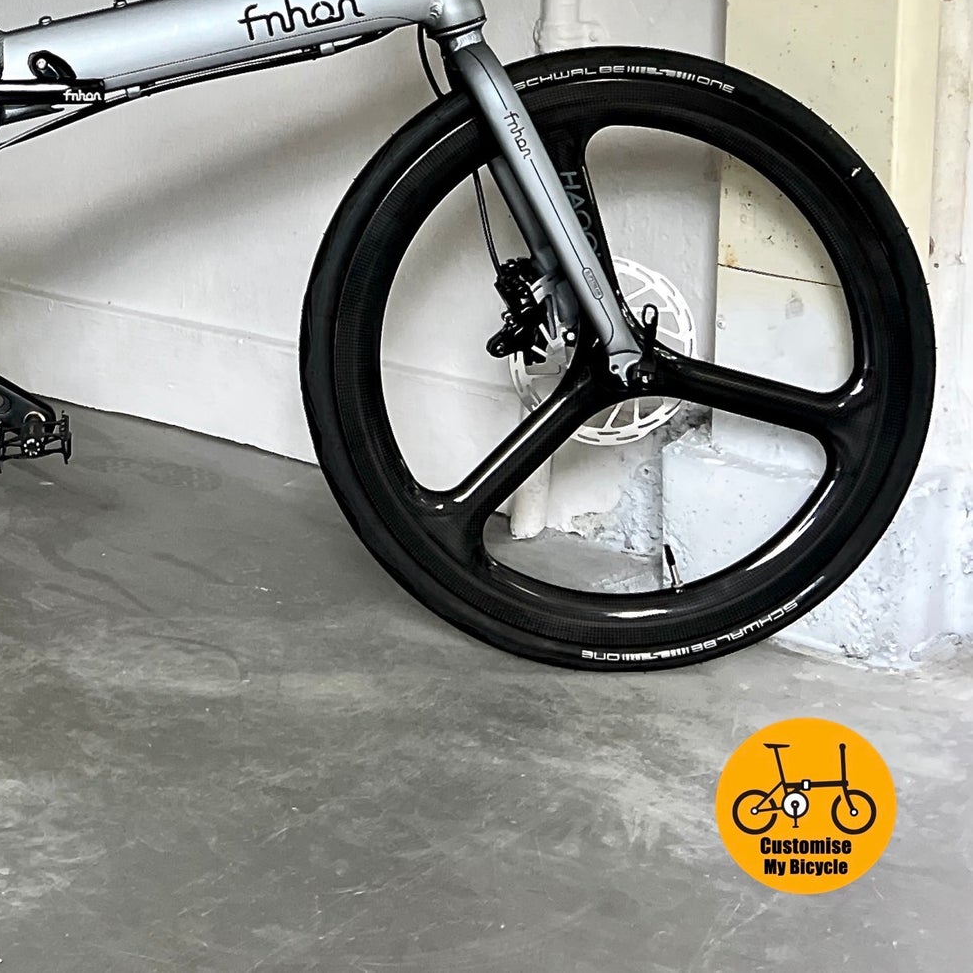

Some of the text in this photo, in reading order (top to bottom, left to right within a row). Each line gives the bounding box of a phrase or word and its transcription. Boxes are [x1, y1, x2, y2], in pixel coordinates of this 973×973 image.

[513, 65, 626, 91] SCHWALBE
[63, 88, 102, 102] fnhon
[503, 110, 532, 160] fnhon
